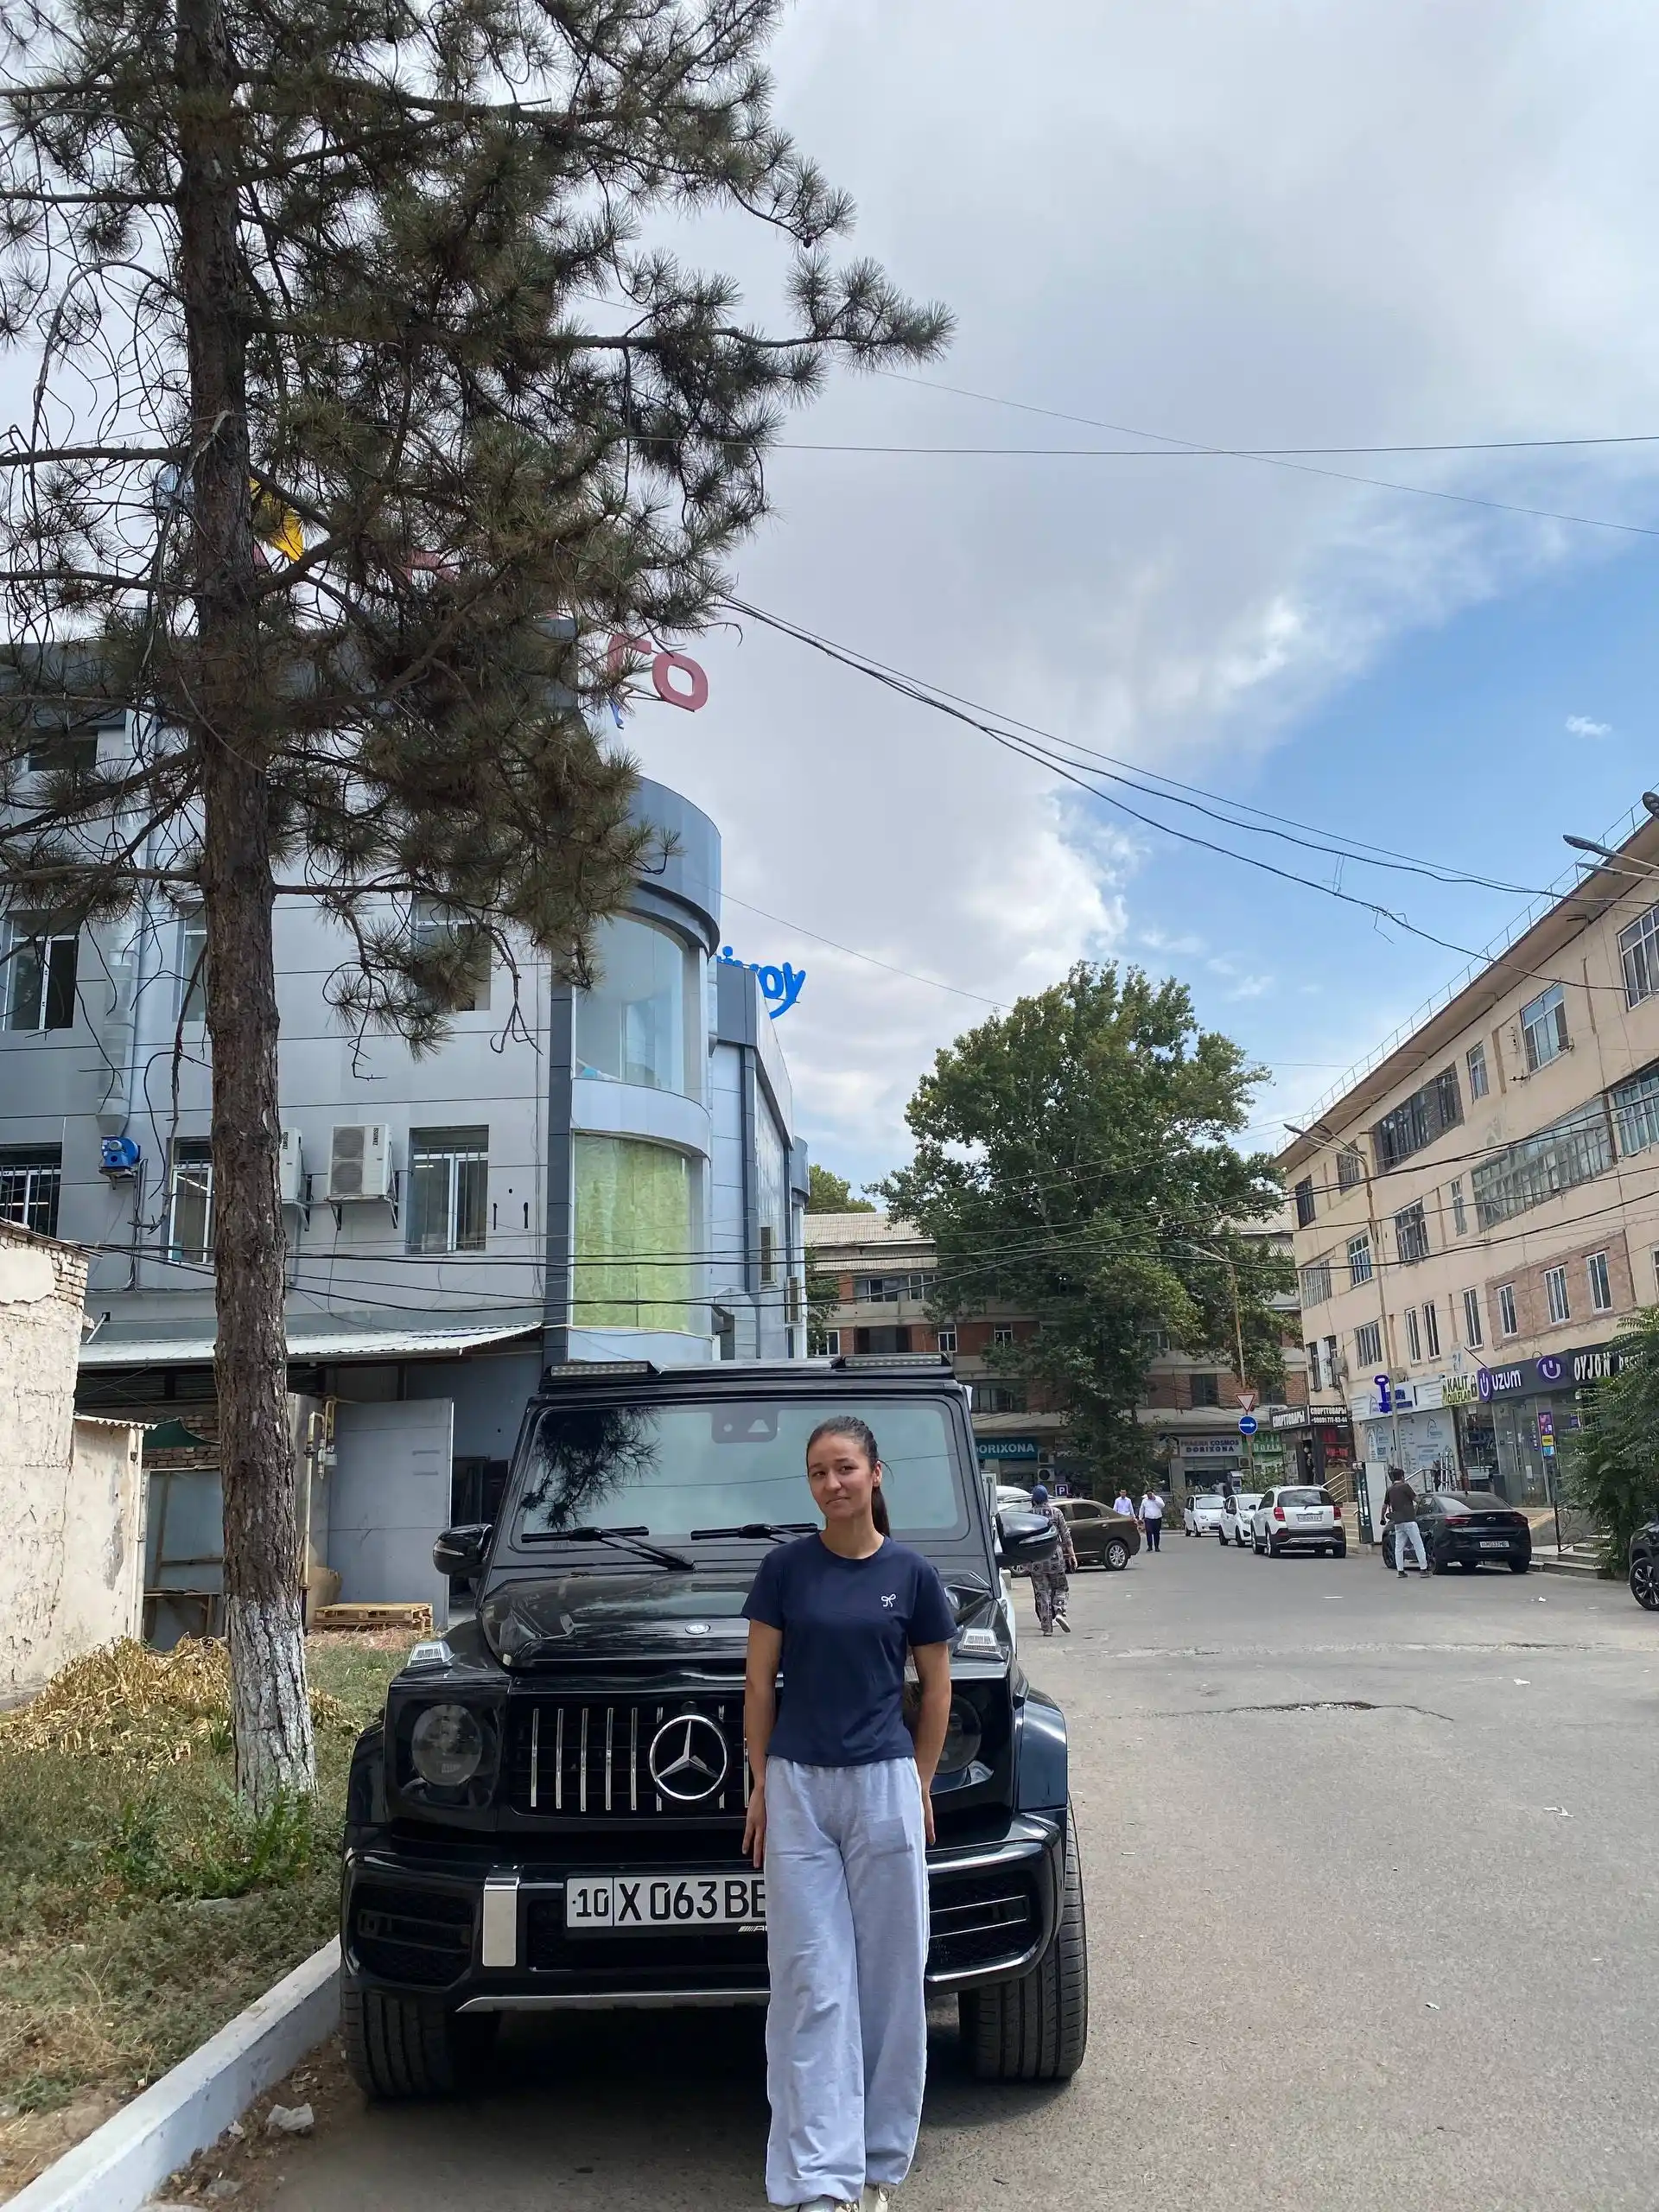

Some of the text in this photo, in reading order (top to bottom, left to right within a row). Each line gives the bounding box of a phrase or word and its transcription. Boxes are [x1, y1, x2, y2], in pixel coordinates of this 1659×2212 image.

[1447, 1375, 1468, 1393] KALIT
[976, 1443, 1035, 1454] ORIXONA
[1058, 1486, 1065, 1495] P
